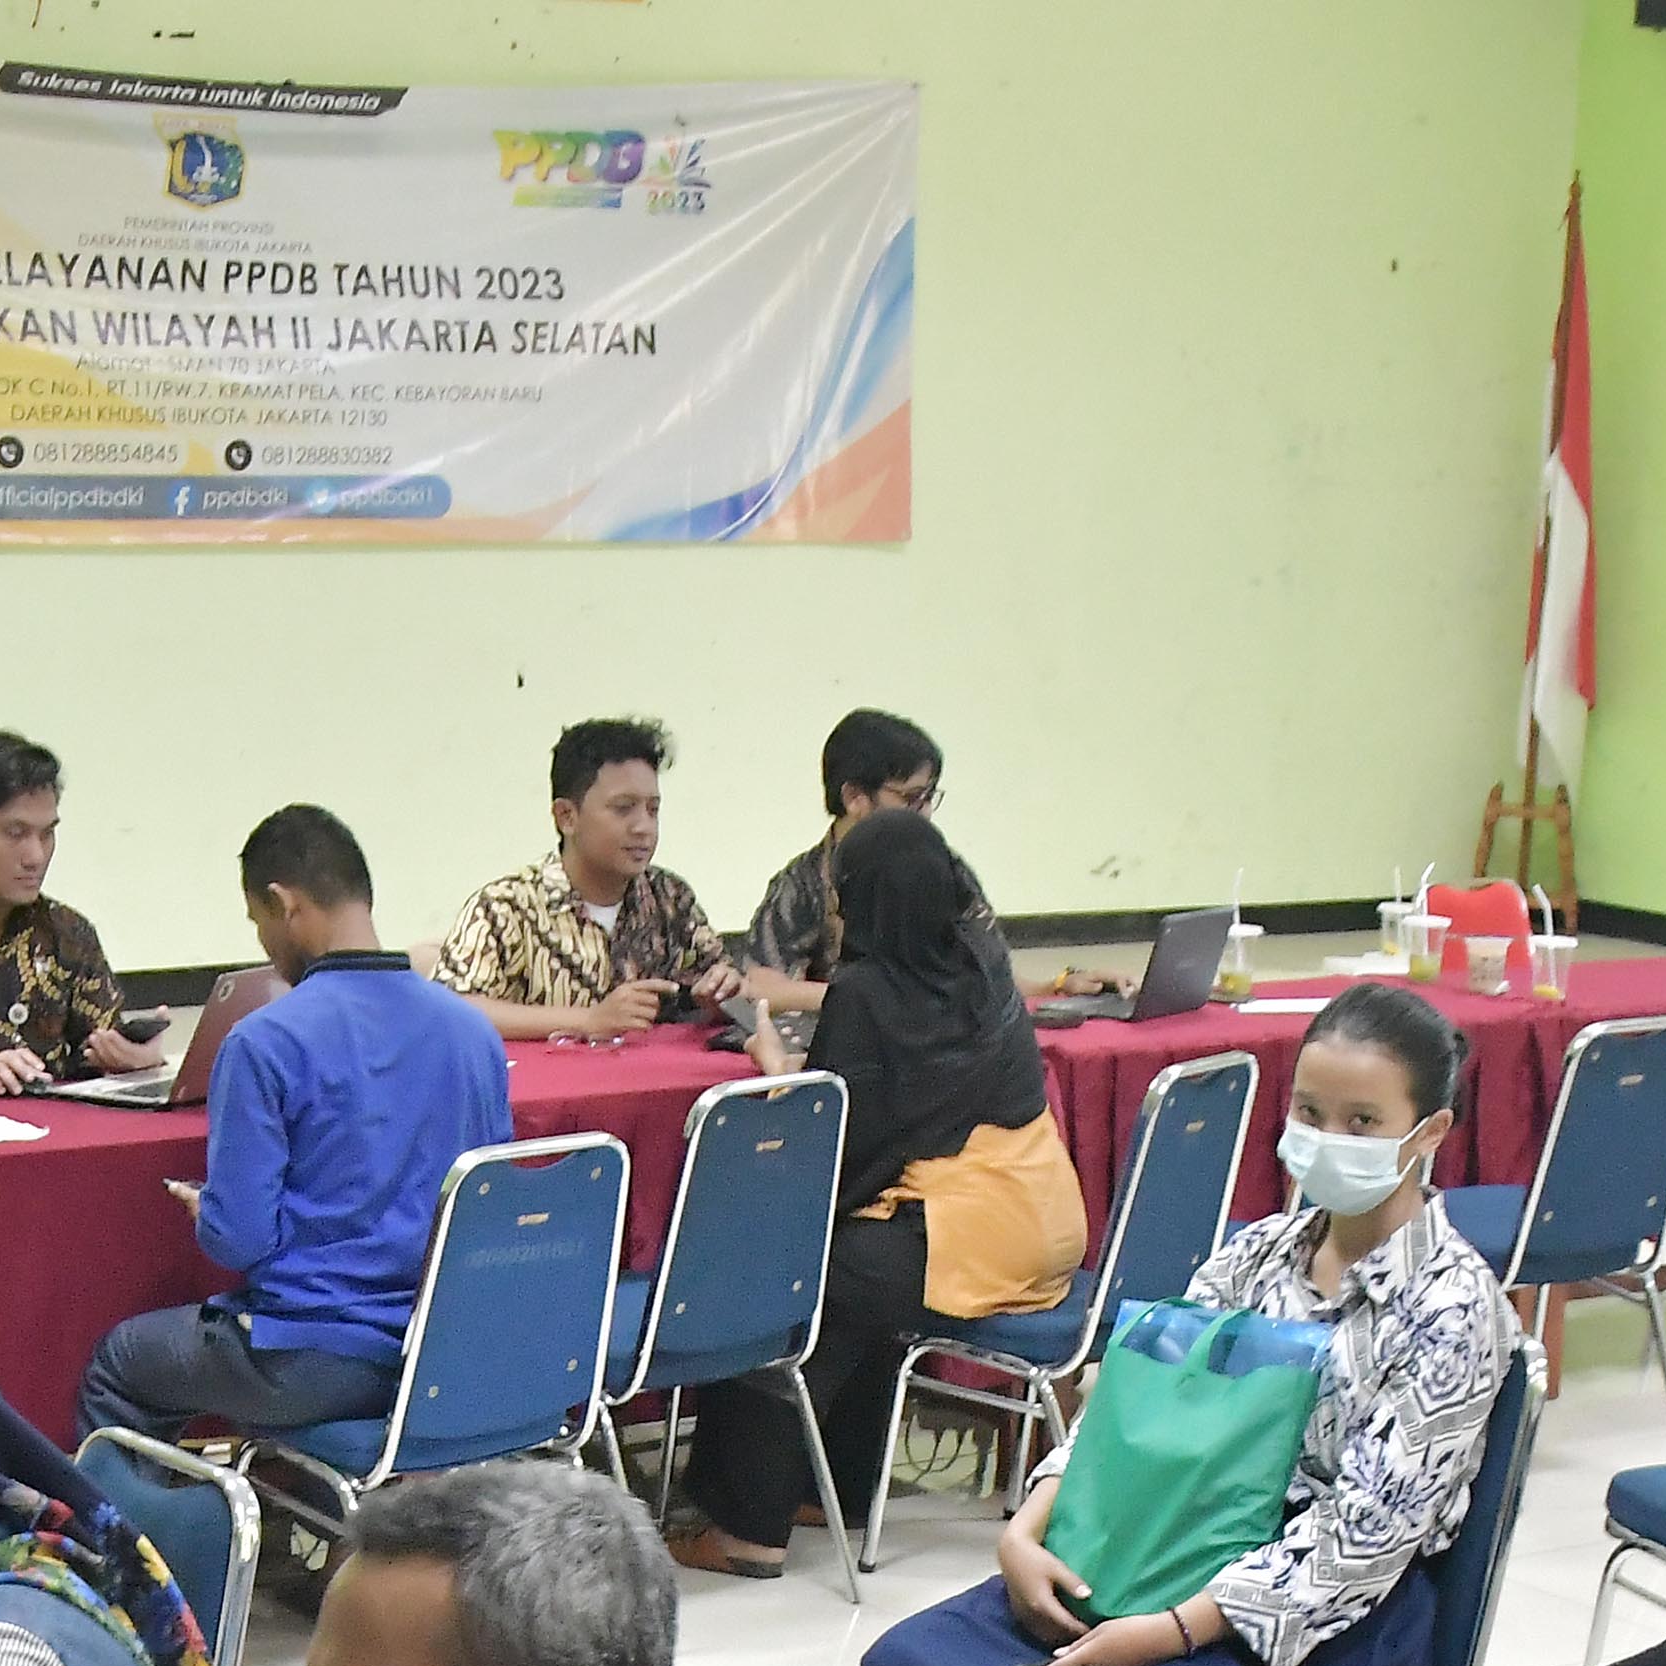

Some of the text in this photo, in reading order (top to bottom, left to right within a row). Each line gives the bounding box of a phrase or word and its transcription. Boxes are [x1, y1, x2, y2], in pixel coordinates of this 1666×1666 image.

[17, 71, 382, 112] Sukses Jakarta untuk Indonesia
[493, 130, 645, 183] PPDB
[123, 215, 275, 236] PEMERINTAH PROVINSI
[78, 232, 134, 249] DAERAH
[139, 235, 191, 251] KHUSUS
[254, 239, 312, 255] JAKARTA
[223, 259, 318, 296] PPDB
[332, 262, 462, 301] TAHUN
[474, 266, 565, 302] 2023
[92, 310, 276, 350] WILAYAH
[290, 315, 312, 351] II
[326, 317, 497, 355] JAKARTA
[510, 321, 658, 357] SELATAN
[256, 357, 336, 377] JAKARTA
[28, 377, 45, 397] C
[218, 382, 293, 401] KRAMAT
[394, 384, 497, 403] KEBAYORAN
[500, 386, 543, 402] BARU
[9, 403, 388, 427] DAERAH KHUSUS IBUKOTA JAKARTA 12130
[32, 441, 178, 464] 081288854845
[203, 486, 290, 511] ppdbdki
